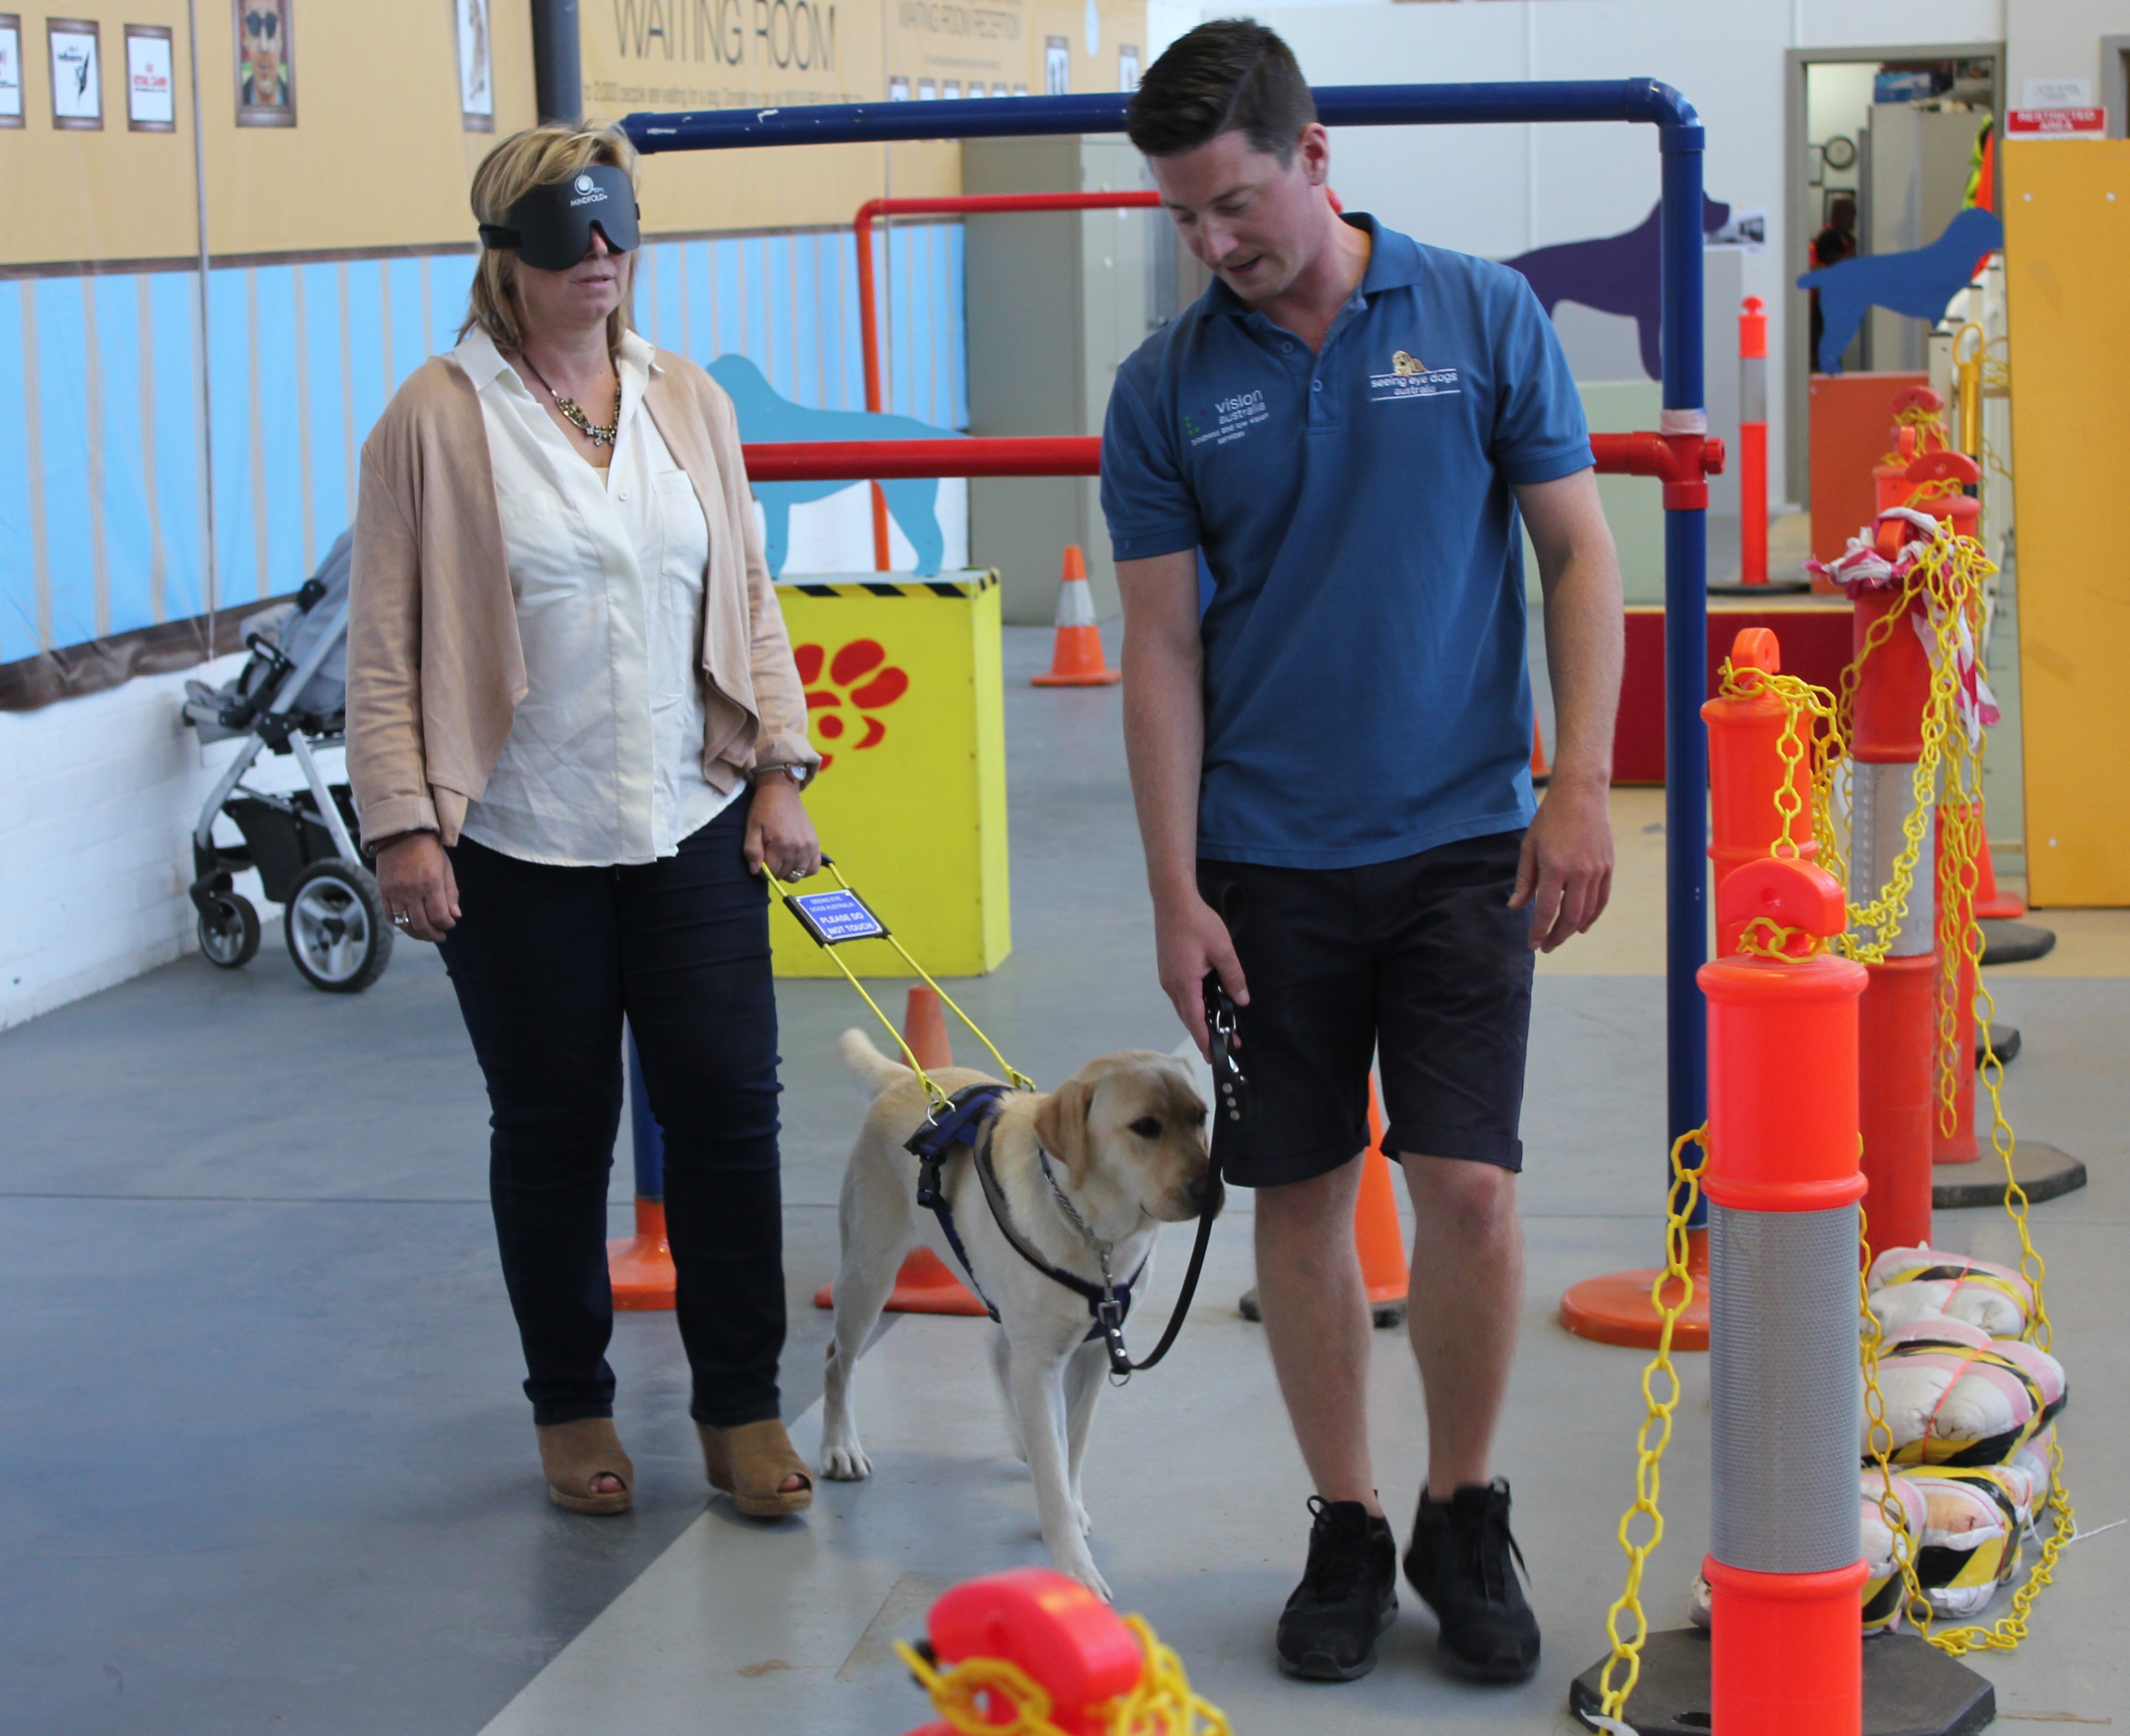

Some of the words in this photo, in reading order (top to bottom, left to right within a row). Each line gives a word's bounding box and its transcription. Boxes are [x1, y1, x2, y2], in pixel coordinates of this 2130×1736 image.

[614, 0, 744, 65] WAITING
[754, 0, 836, 70] ROOM
[2017, 109, 2096, 122] RESTRICTED
[2040, 120, 2075, 131] AREA
[1370, 375, 1408, 388] seeing
[1408, 376, 1429, 387] eye
[1430, 371, 1458, 384] dogs
[1394, 384, 1437, 395] australia
[1214, 390, 1263, 413] vision
[1219, 402, 1267, 425] australia
[827, 902, 855, 910] AUSTRALIA
[819, 913, 851, 924] PLEASE
[850, 912, 864, 921] DO
[827, 925, 845, 935] NOT
[844, 922, 873, 932] TOUCH
